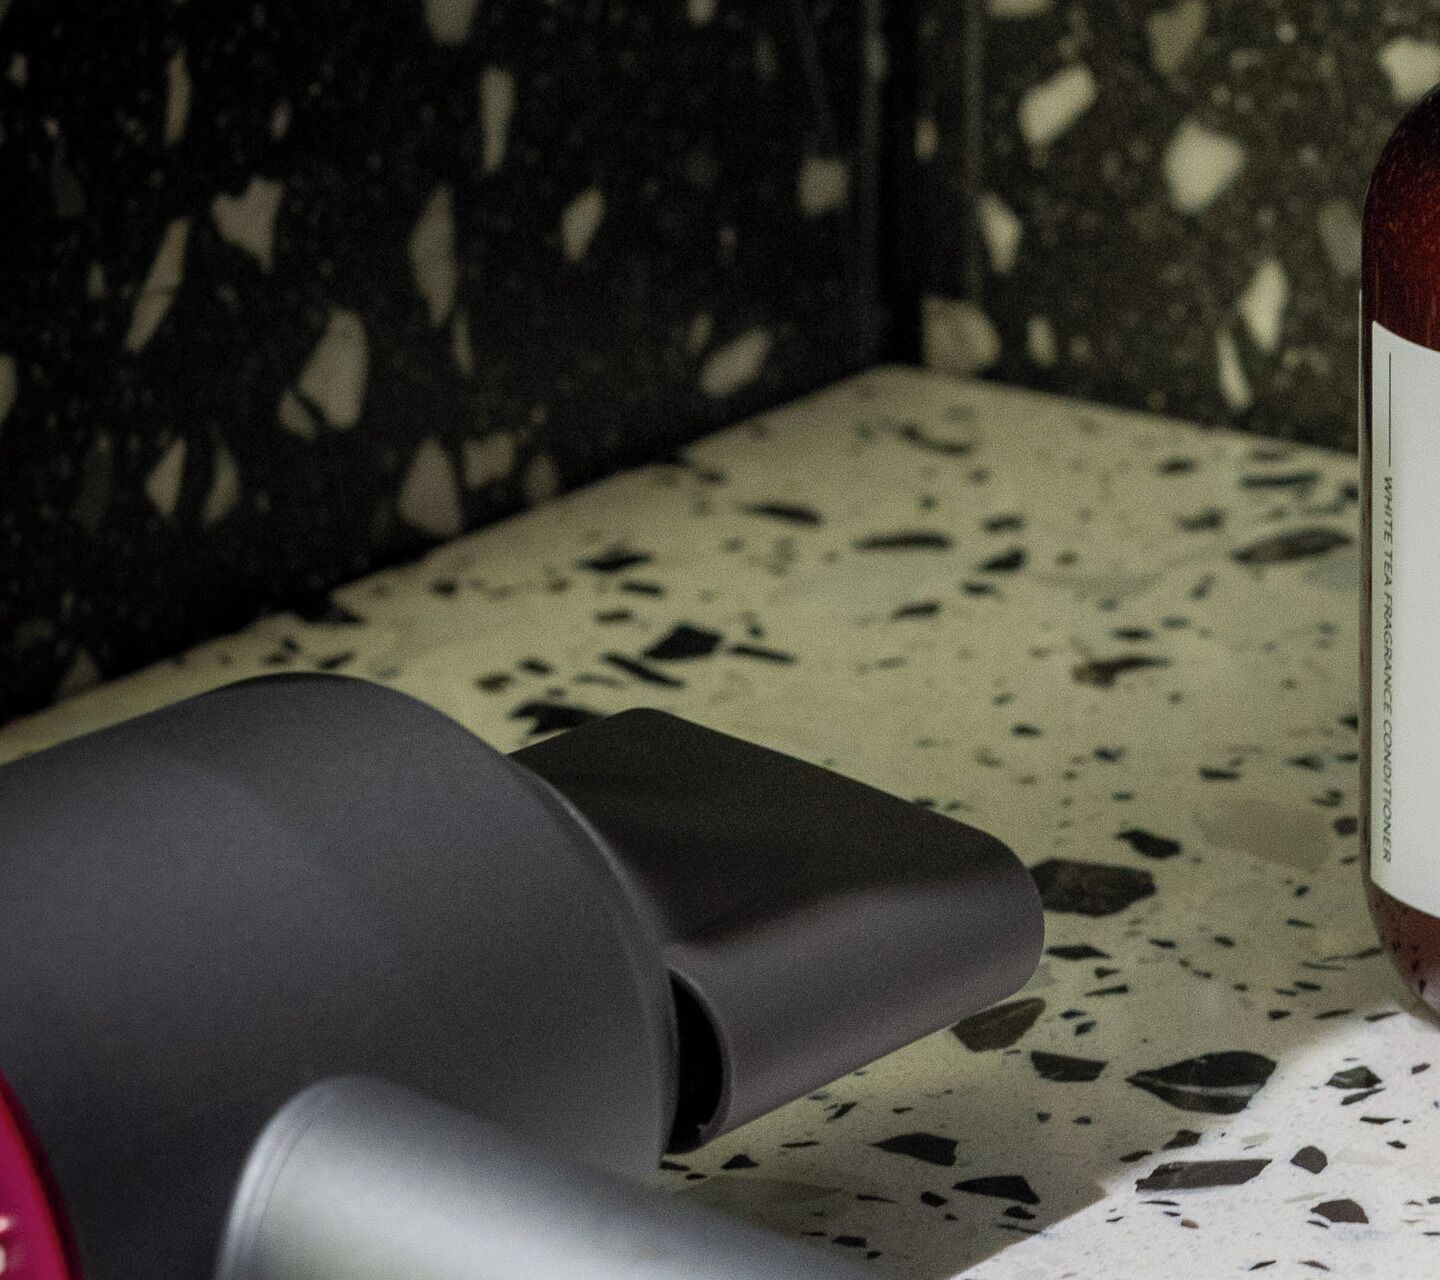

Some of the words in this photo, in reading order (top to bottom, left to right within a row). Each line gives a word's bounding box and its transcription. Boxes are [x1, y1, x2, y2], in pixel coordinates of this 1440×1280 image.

[1383, 477, 1393, 544] WHITE
[1383, 550, 1393, 586] TEA
[1383, 592, 1393, 715] FRAGRANCE
[1382, 719, 1393, 863] CONDITIONER
